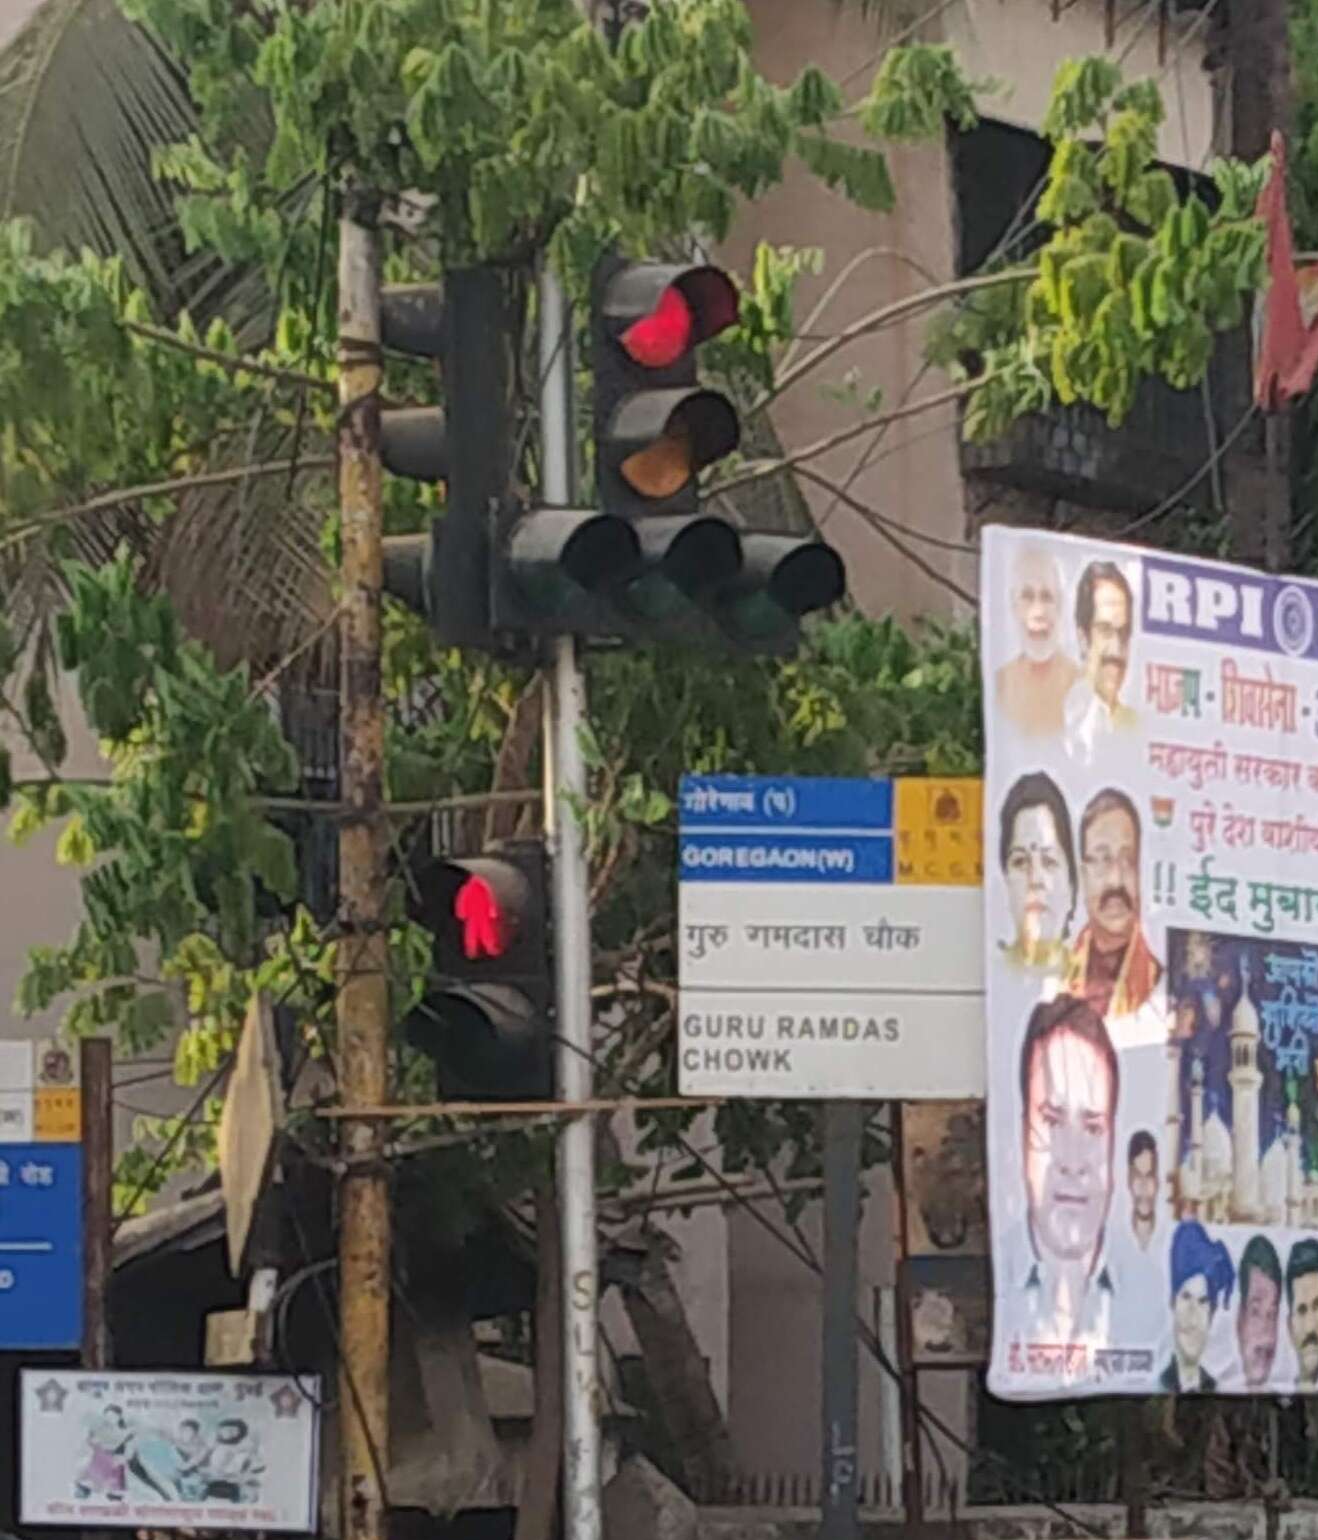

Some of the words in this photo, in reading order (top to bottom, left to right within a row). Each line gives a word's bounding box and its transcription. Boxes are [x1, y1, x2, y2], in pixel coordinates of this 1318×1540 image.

[1146, 568, 1264, 638] RPI
[1221, 658, 1297, 733] शिवसेना
[1234, 754, 1302, 791] सरकार
[1222, 802, 1255, 847] देश
[1187, 855, 1238, 921] ईद
[686, 924, 728, 958] गुरु
[862, 917, 921, 949] चौक
[683, 1014, 765, 1040] GURU
[777, 1016, 899, 1042] RAMDAS
[683, 1049, 792, 1072] CHOWK
